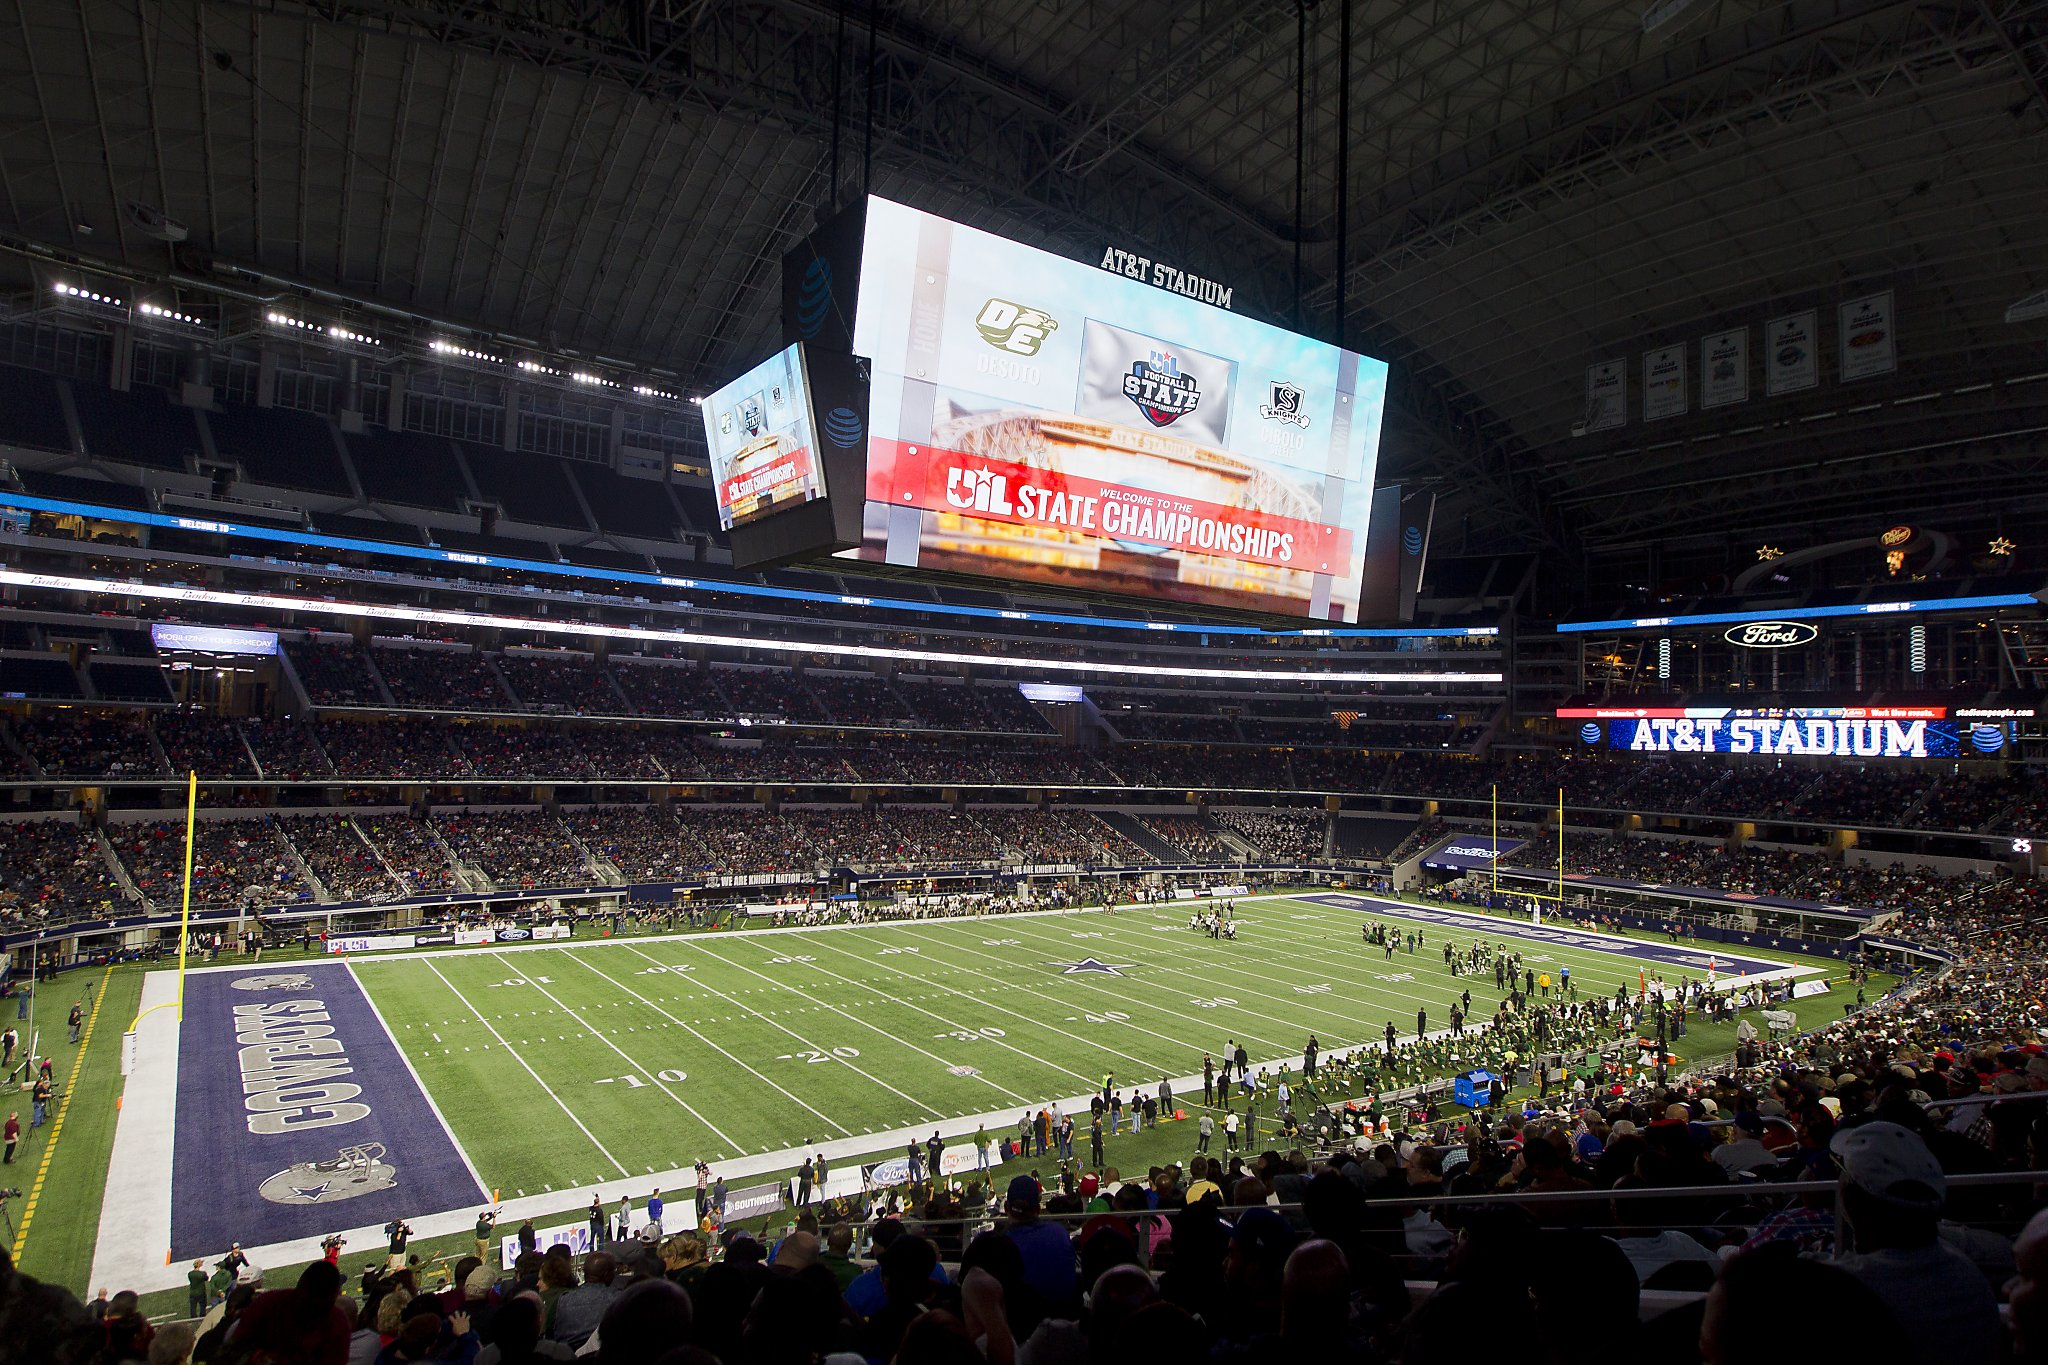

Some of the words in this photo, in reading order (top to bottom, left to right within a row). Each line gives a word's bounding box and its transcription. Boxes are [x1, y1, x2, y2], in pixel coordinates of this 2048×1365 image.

[1101, 246, 1150, 281] AT&T
[1153, 262, 1233, 309] STADIUM
[976, 353, 1041, 386] DESOTO
[1144, 369, 1186, 389] FOOTBALL
[1124, 375, 1200, 410] STATE
[1138, 396, 1182, 414] CHAMPIONSHIPS
[1267, 409, 1302, 424] KNIGHTS
[1261, 427, 1304, 451] CIBOLO
[753, 460, 796, 492] CHAMPIONSHIPS
[1100, 487, 1154, 506] WELCOME
[1157, 499, 1171, 509] TO
[1173, 501, 1193, 513] THE
[178, 518, 218, 532] WELCOME
[219, 523, 230, 533] TO
[1017, 484, 1098, 529] STATE
[1102, 501, 1294, 562] CHAMPIONSHIPS
[447, 553, 479, 564] WELCOME
[479, 556, 487, 565] TO
[308, 568, 337, 577] DARREN
[339, 571, 375, 580] WOODSON
[30, 576, 71, 588] Baden
[105, 583, 142, 594] Baden
[459, 585, 487, 593] CHARLES
[182, 591, 218, 601] Baden
[241, 597, 274, 606] Baden
[302, 602, 334, 612] Baden
[366, 608, 396, 617] Baden
[416, 612, 444, 621] Baden
[467, 617, 495, 625] Baden
[522, 621, 547, 630] Baden
[157, 632, 206, 645] MOBILIZING
[233, 638, 273, 647] GAMEDAY
[1743, 624, 1798, 643] Ford
[1871, 709, 1889, 717] Work
[1908, 709, 1935, 717] events.
[1956, 708, 2035, 718] stadiumpeople.com
[1630, 718, 1722, 753] AT&T
[1730, 718, 1928, 758] STADIUM
[1013, 865, 1023, 874] WE
[1023, 864, 1034, 874] ARE
[1035, 864, 1056, 873] KNIGHT
[1056, 863, 1076, 872] NATION
[721, 876, 732, 887] WE
[734, 875, 748, 886] ARE
[749, 873, 775, 885] KNIGHT
[776, 872, 801, 884] NATION
[646, 964, 696, 974] 20
[503, 975, 556, 986] 10
[1189, 997, 1239, 1008] 50
[1084, 1011, 1131, 1023] 40
[949, 1027, 1006, 1041] 30
[796, 1046, 861, 1064] 20
[232, 999, 372, 1135] COWBOYS
[617, 1069, 688, 1089] 10
[734, 1192, 780, 1211] SOUTHWEST
